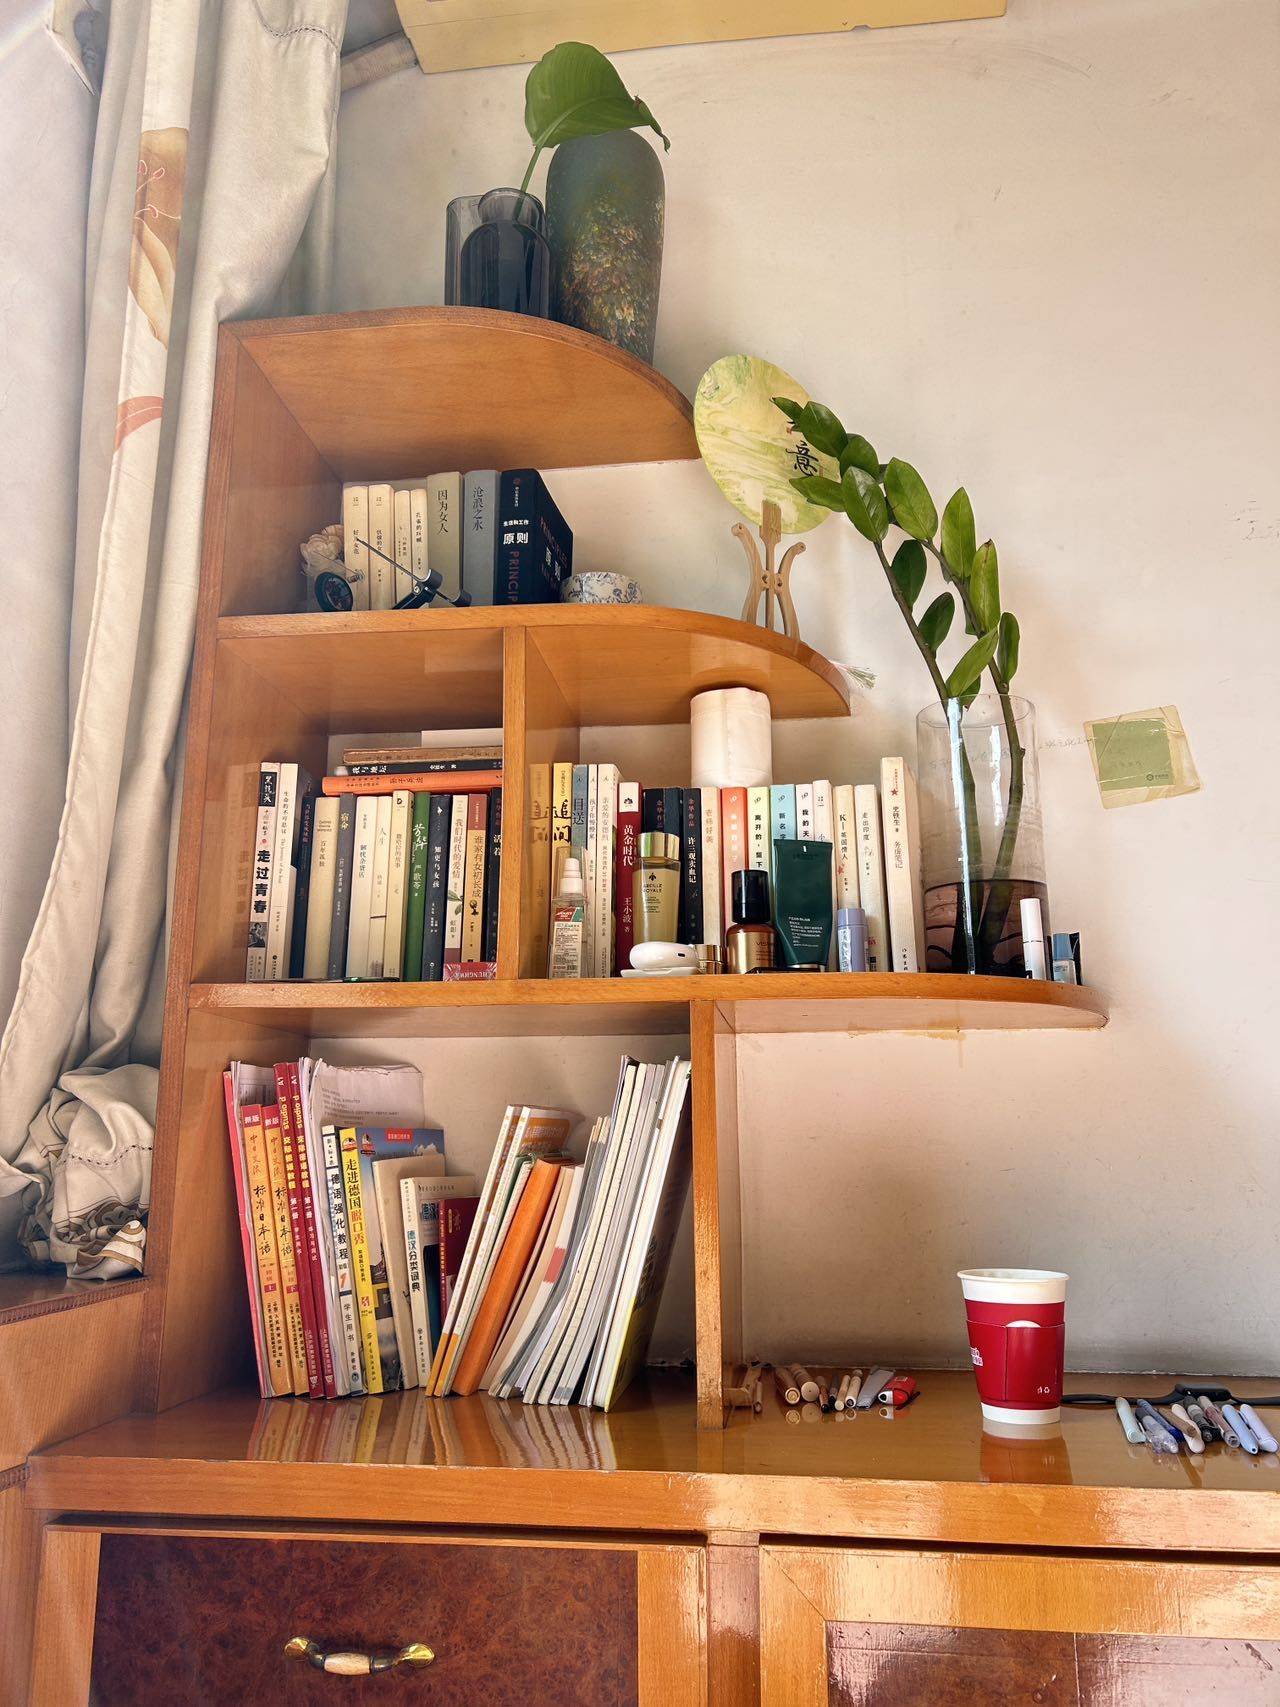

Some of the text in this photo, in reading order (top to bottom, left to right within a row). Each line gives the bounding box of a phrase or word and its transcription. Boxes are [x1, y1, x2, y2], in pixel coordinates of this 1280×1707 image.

[785, 440, 819, 476] 意
[438, 489, 448, 534] 因为女人
[472, 486, 484, 531] 沧浪之水
[503, 532, 529, 545] 原则
[352, 765, 387, 774] 我与地坛
[572, 798, 585, 825] 目送
[802, 809, 810, 837] 我的天
[413, 823, 428, 850] 芳华
[452, 818, 463, 879] 我们时代的爱情
[622, 824, 634, 867] 黄金时代
[254, 850, 270, 913] 走过青春
[688, 837, 697, 883] 许三观卖血记
[622, 897, 632, 923] 王小波
[253, 1185, 270, 1255] 标准日本语
[275, 1187, 292, 1256] 标准日本语
[331, 1173, 348, 1260] 德语强化教程
[346, 1158, 365, 1246] 走进德国脱口秀
[340, 1272, 347, 1289] 1
[407, 1230, 420, 1292] 德汉分类词典
[343, 1303, 355, 1341] 学生用书
